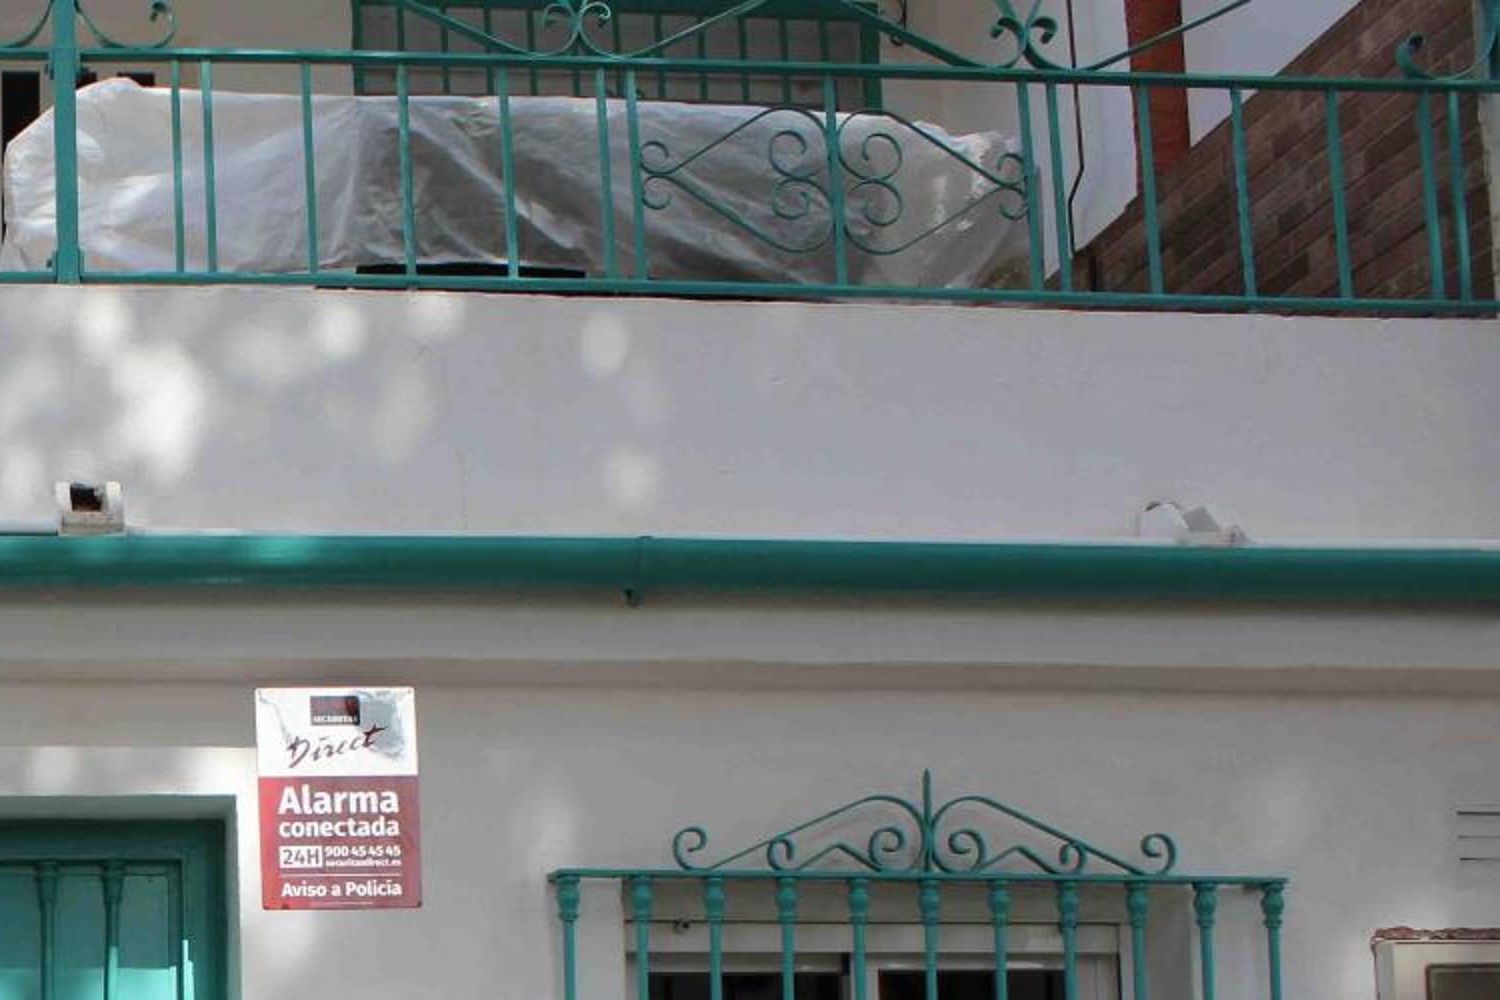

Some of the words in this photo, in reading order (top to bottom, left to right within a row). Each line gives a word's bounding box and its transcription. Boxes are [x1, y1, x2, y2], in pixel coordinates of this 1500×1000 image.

[278, 784, 399, 815] Alarma
[279, 815, 400, 838] conectada
[283, 849, 320, 865] 24H
[324, 845, 349, 857] 900
[282, 880, 327, 897] Aviso
[331, 884, 341, 897] a
